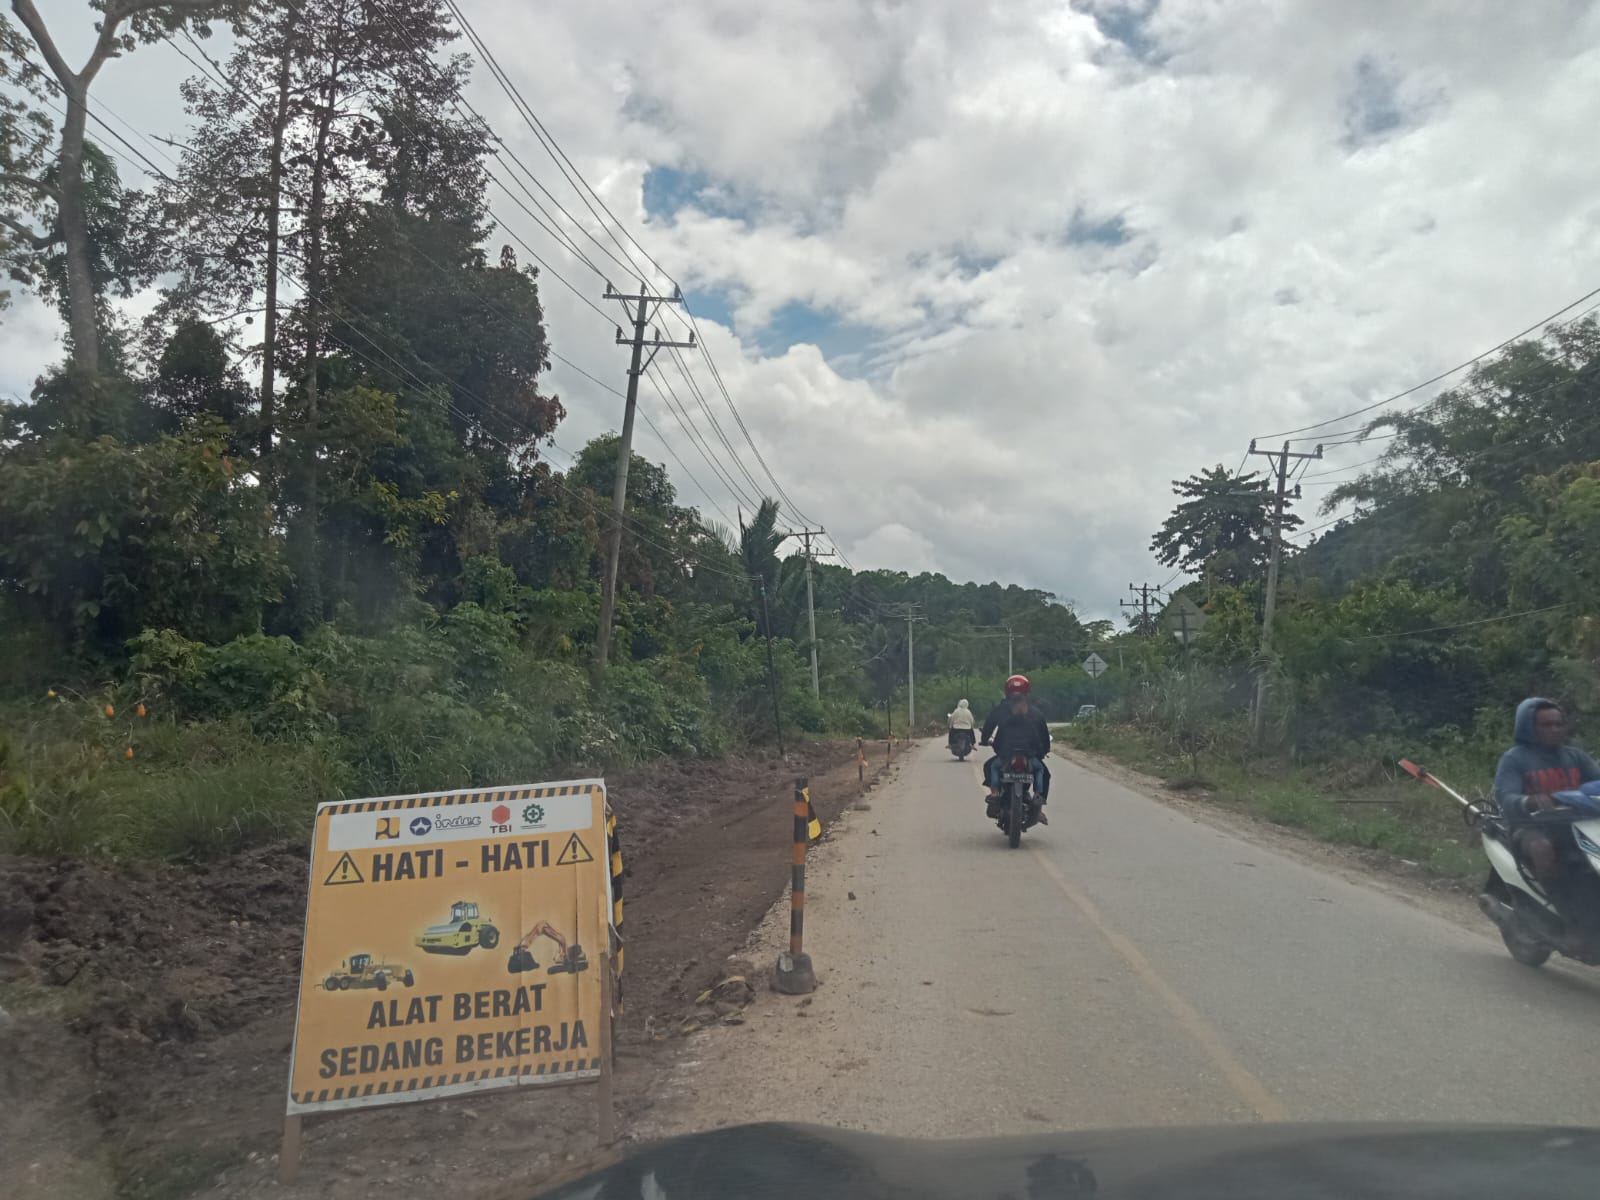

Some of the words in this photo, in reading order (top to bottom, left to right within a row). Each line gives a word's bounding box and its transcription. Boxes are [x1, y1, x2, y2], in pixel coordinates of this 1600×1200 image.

[490, 824, 512, 834] TBI
[372, 849, 443, 883] HATI
[481, 840, 550, 874] HATI
[367, 995, 443, 1030] ALAT
[454, 984, 546, 1021] BERAT
[319, 1038, 443, 1079] SEDANG
[456, 1020, 588, 1064] BEKERJA
